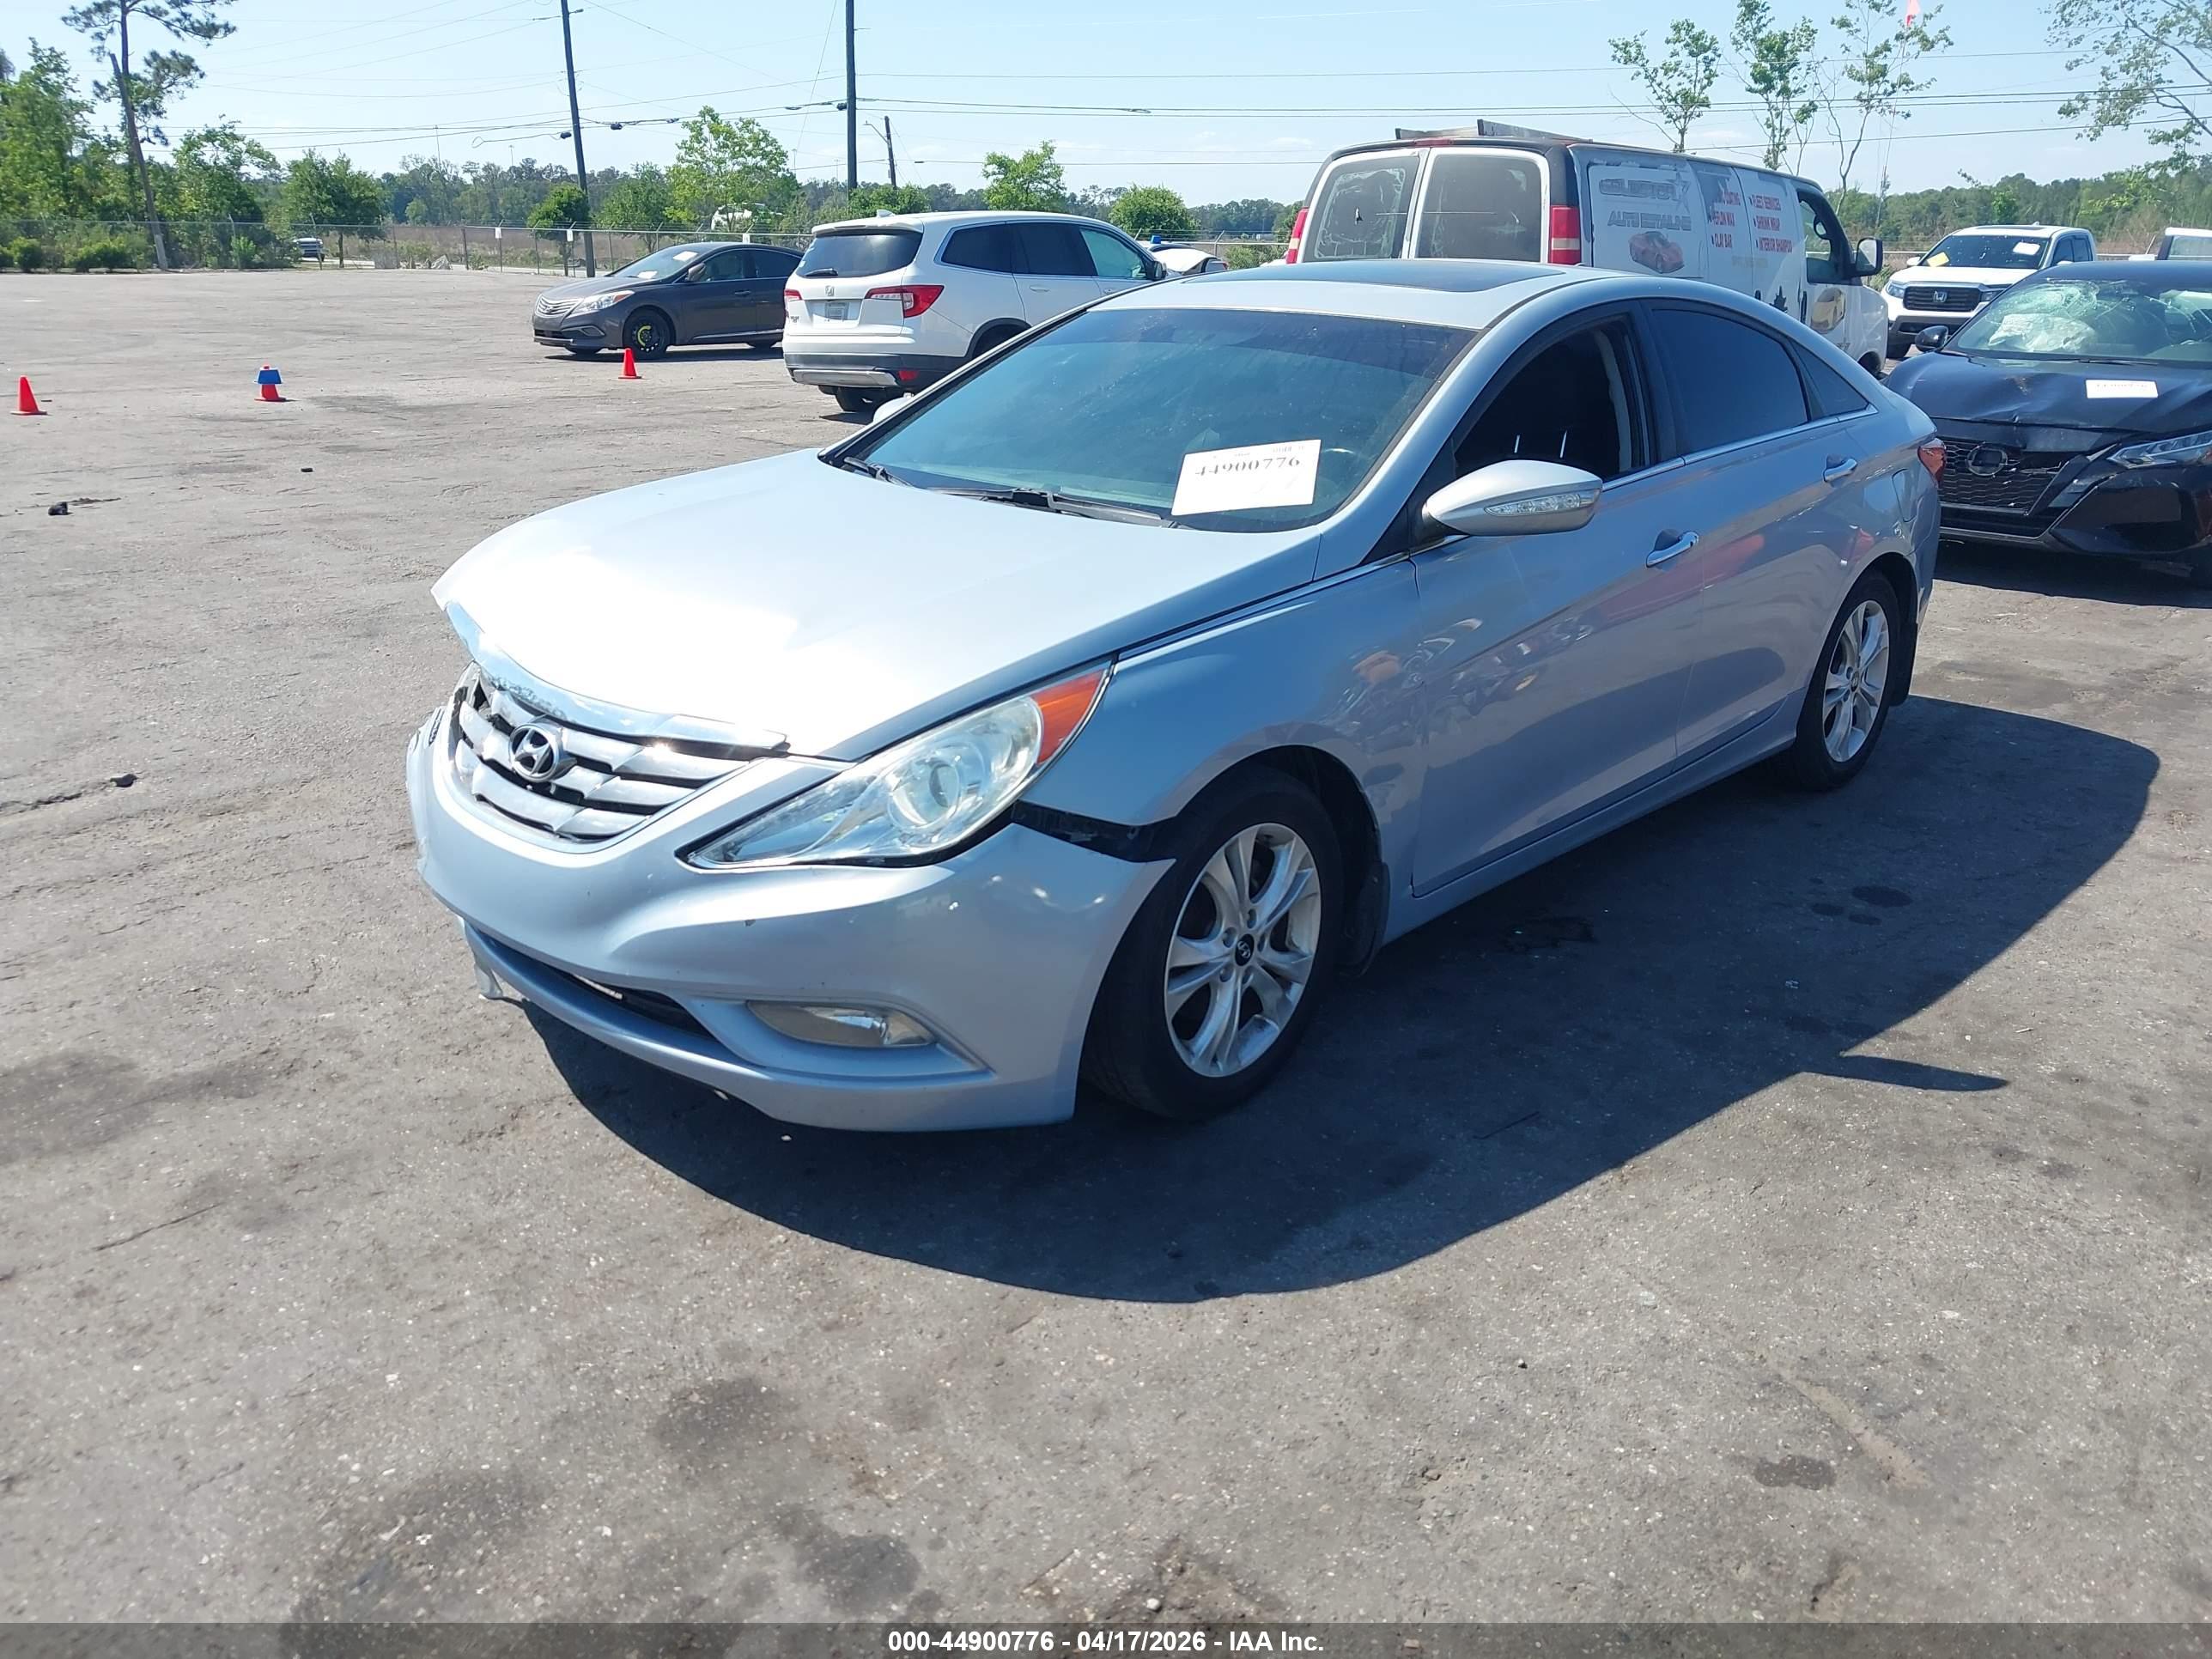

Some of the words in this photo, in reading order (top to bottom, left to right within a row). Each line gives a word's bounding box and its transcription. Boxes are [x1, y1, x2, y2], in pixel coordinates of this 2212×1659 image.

[1607, 210, 1640, 228] AUTO
[1724, 234, 1733, 247] BAR
[1194, 456, 1300, 477] 44900776
